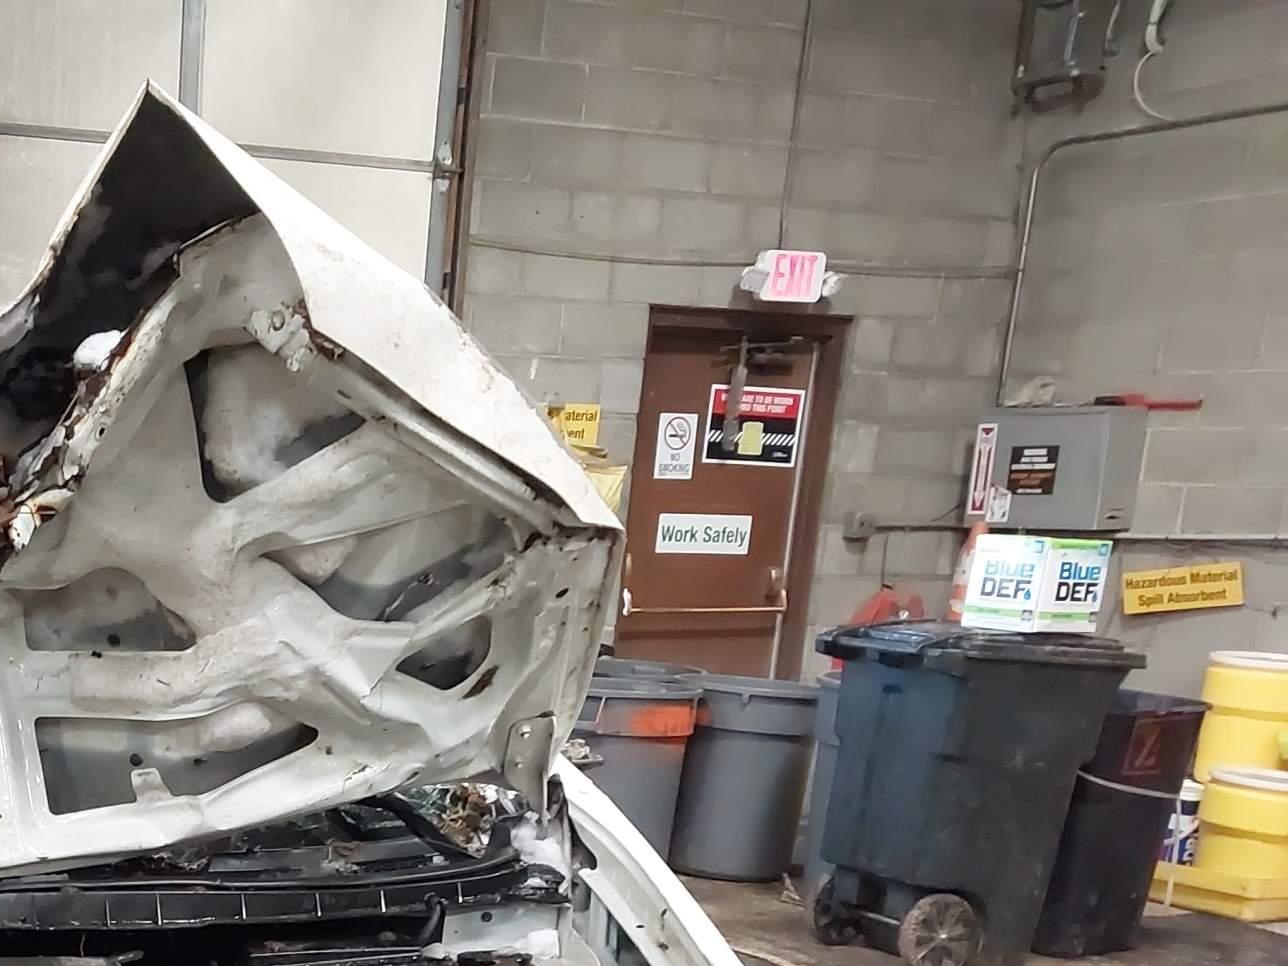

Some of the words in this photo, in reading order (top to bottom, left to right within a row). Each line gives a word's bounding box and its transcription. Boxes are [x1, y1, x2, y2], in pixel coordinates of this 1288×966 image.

[771, 253, 818, 297] EXIT
[563, 409, 598, 423] aterial
[669, 453, 681, 462] NO
[658, 463, 690, 473] SMOKING
[661, 525, 699, 543] Work
[703, 526, 748, 548] Safely
[984, 560, 1037, 579] Blue
[1059, 561, 1102, 581] Blue
[1125, 575, 1187, 590] Hazardous
[1190, 569, 1238, 584] Material
[980, 577, 1033, 599] DEF
[1055, 582, 1100, 602] DEF
[1138, 593, 1164, 607] Spill
[1167, 588, 1227, 603] Absorbent
